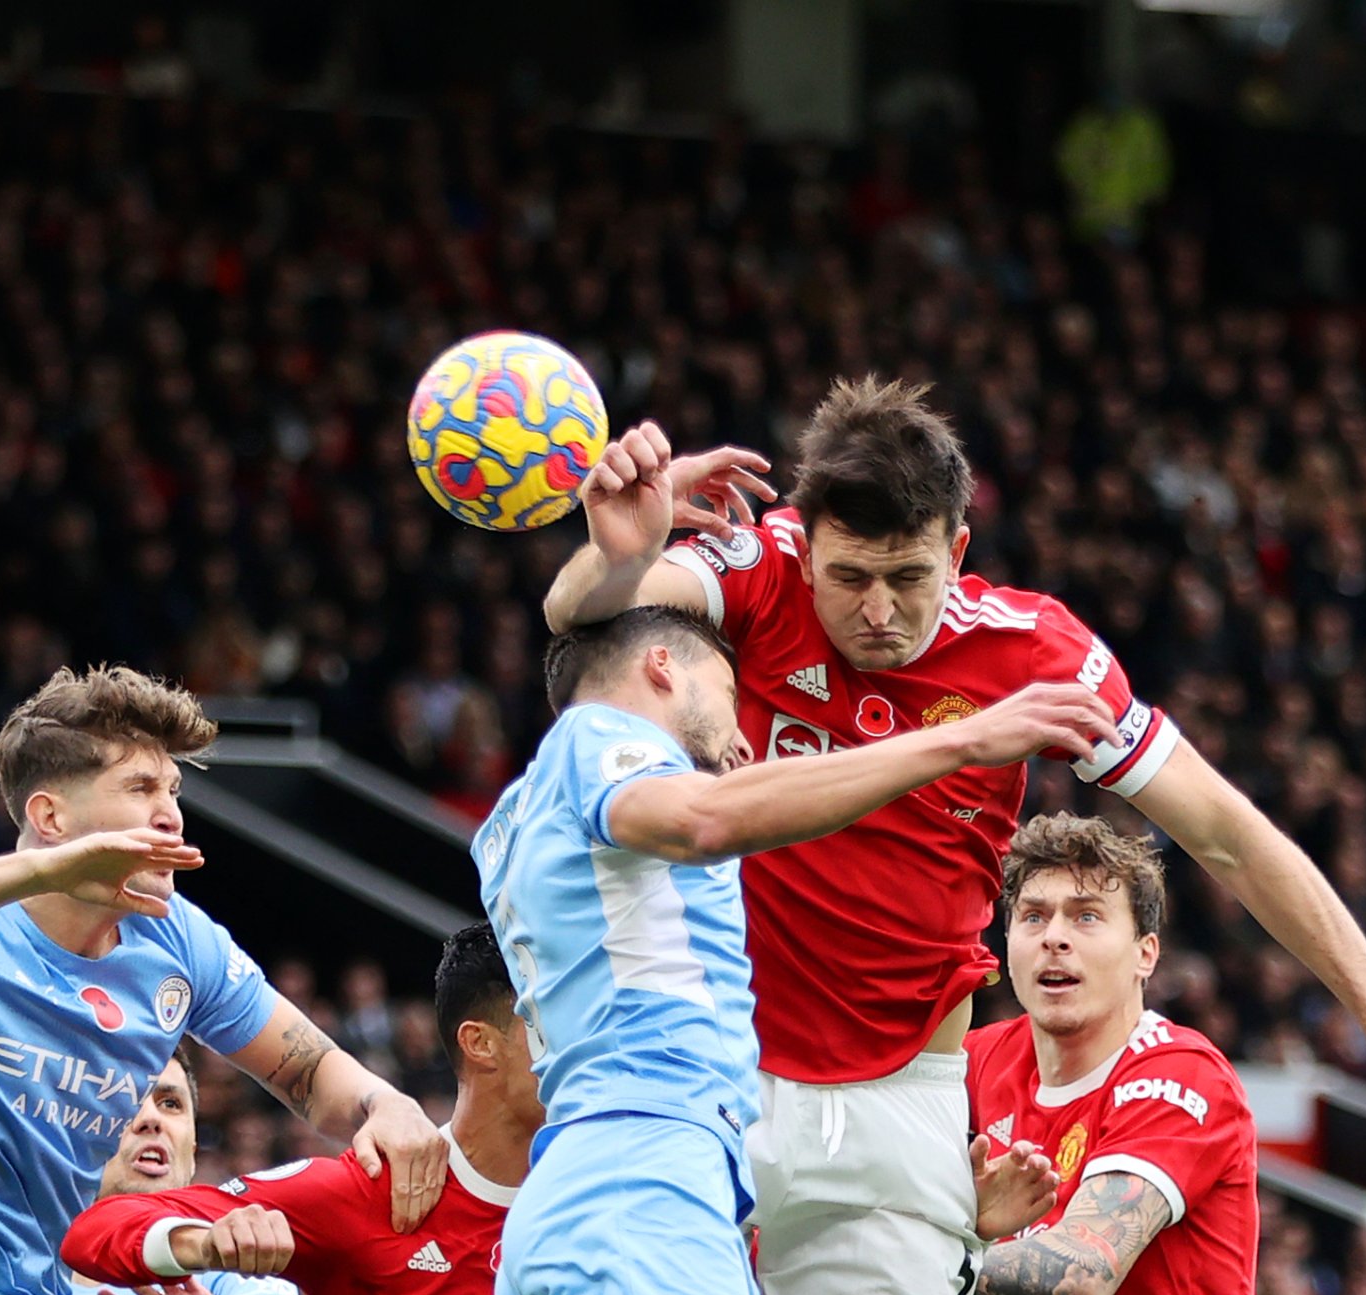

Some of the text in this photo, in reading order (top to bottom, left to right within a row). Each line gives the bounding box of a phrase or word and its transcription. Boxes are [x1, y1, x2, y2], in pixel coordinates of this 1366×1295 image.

[1076, 635, 1113, 694] KOH
[786, 673, 832, 703] adidas
[925, 699, 975, 722] MANCHEST
[1113, 1077, 1210, 1127] KOHLER
[407, 1258, 453, 1274] adidas
